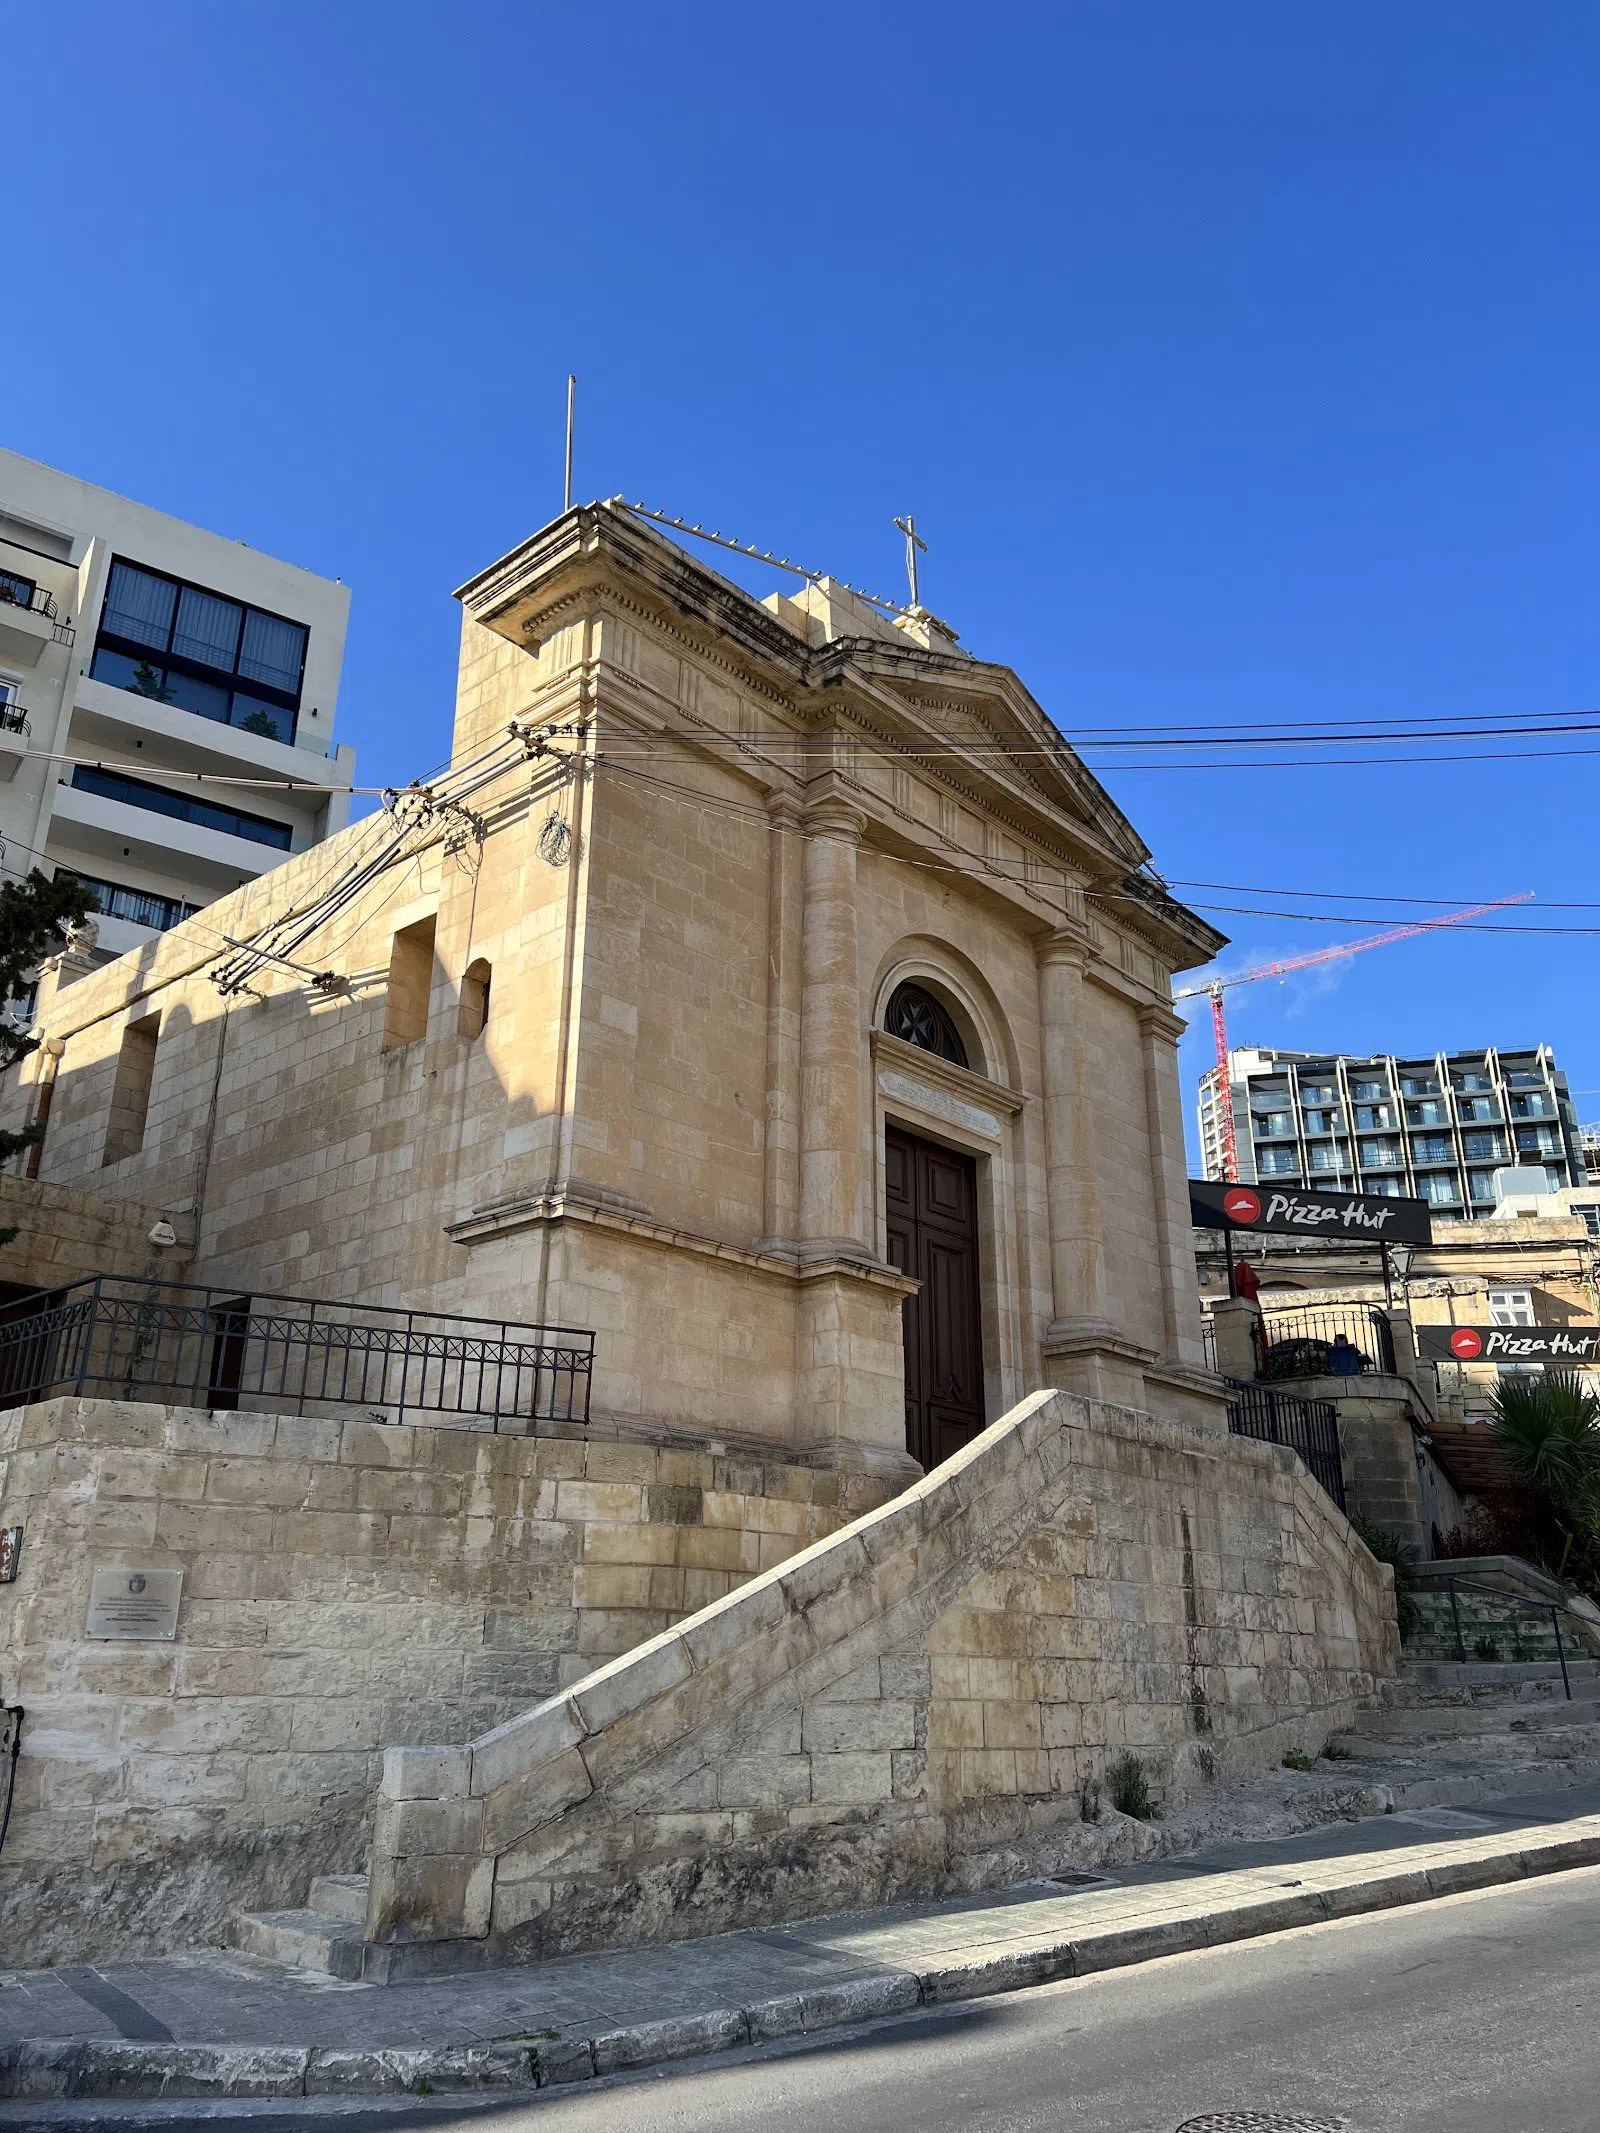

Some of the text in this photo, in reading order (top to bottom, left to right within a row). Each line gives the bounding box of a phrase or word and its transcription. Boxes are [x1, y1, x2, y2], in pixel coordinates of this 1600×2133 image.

[1266, 1194, 1396, 1229] Pizza Hut
[1486, 1331, 1597, 1356] Pizza Hut
